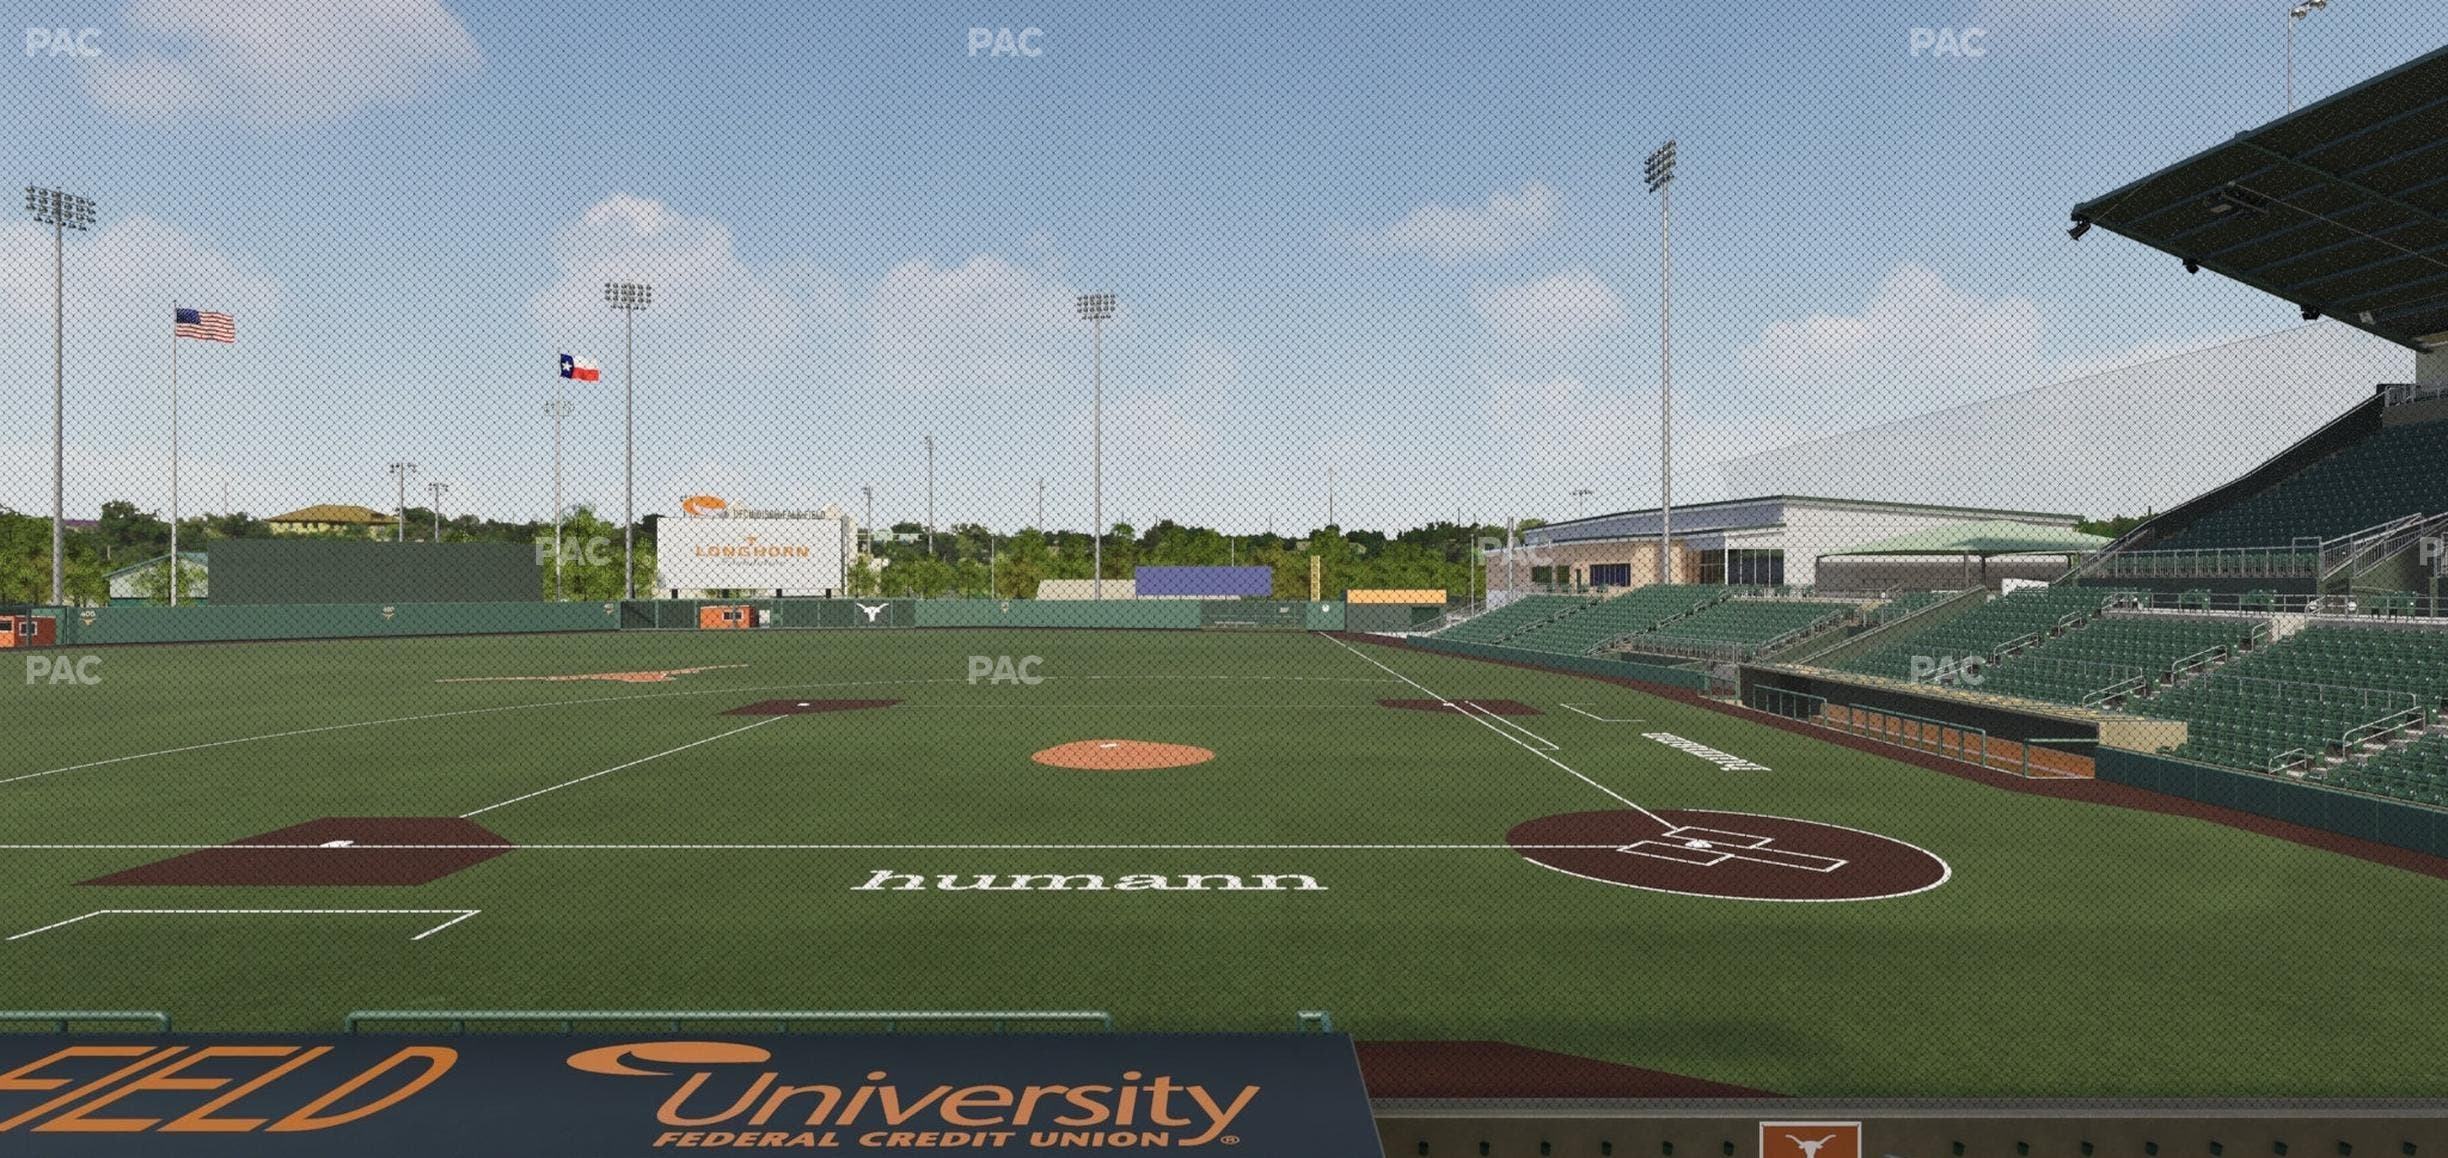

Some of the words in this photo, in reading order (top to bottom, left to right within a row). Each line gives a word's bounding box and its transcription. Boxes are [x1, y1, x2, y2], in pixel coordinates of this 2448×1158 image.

[695, 546, 810, 558] LONGHORN
[850, 870, 1329, 891] humann
[0, 1046, 458, 1132] FIELD
[654, 1070, 1261, 1147] University
[651, 1131, 839, 1148] FEDERAL
[859, 1131, 1017, 1148] CREDIT
[1043, 1131, 1171, 1148] UNION
